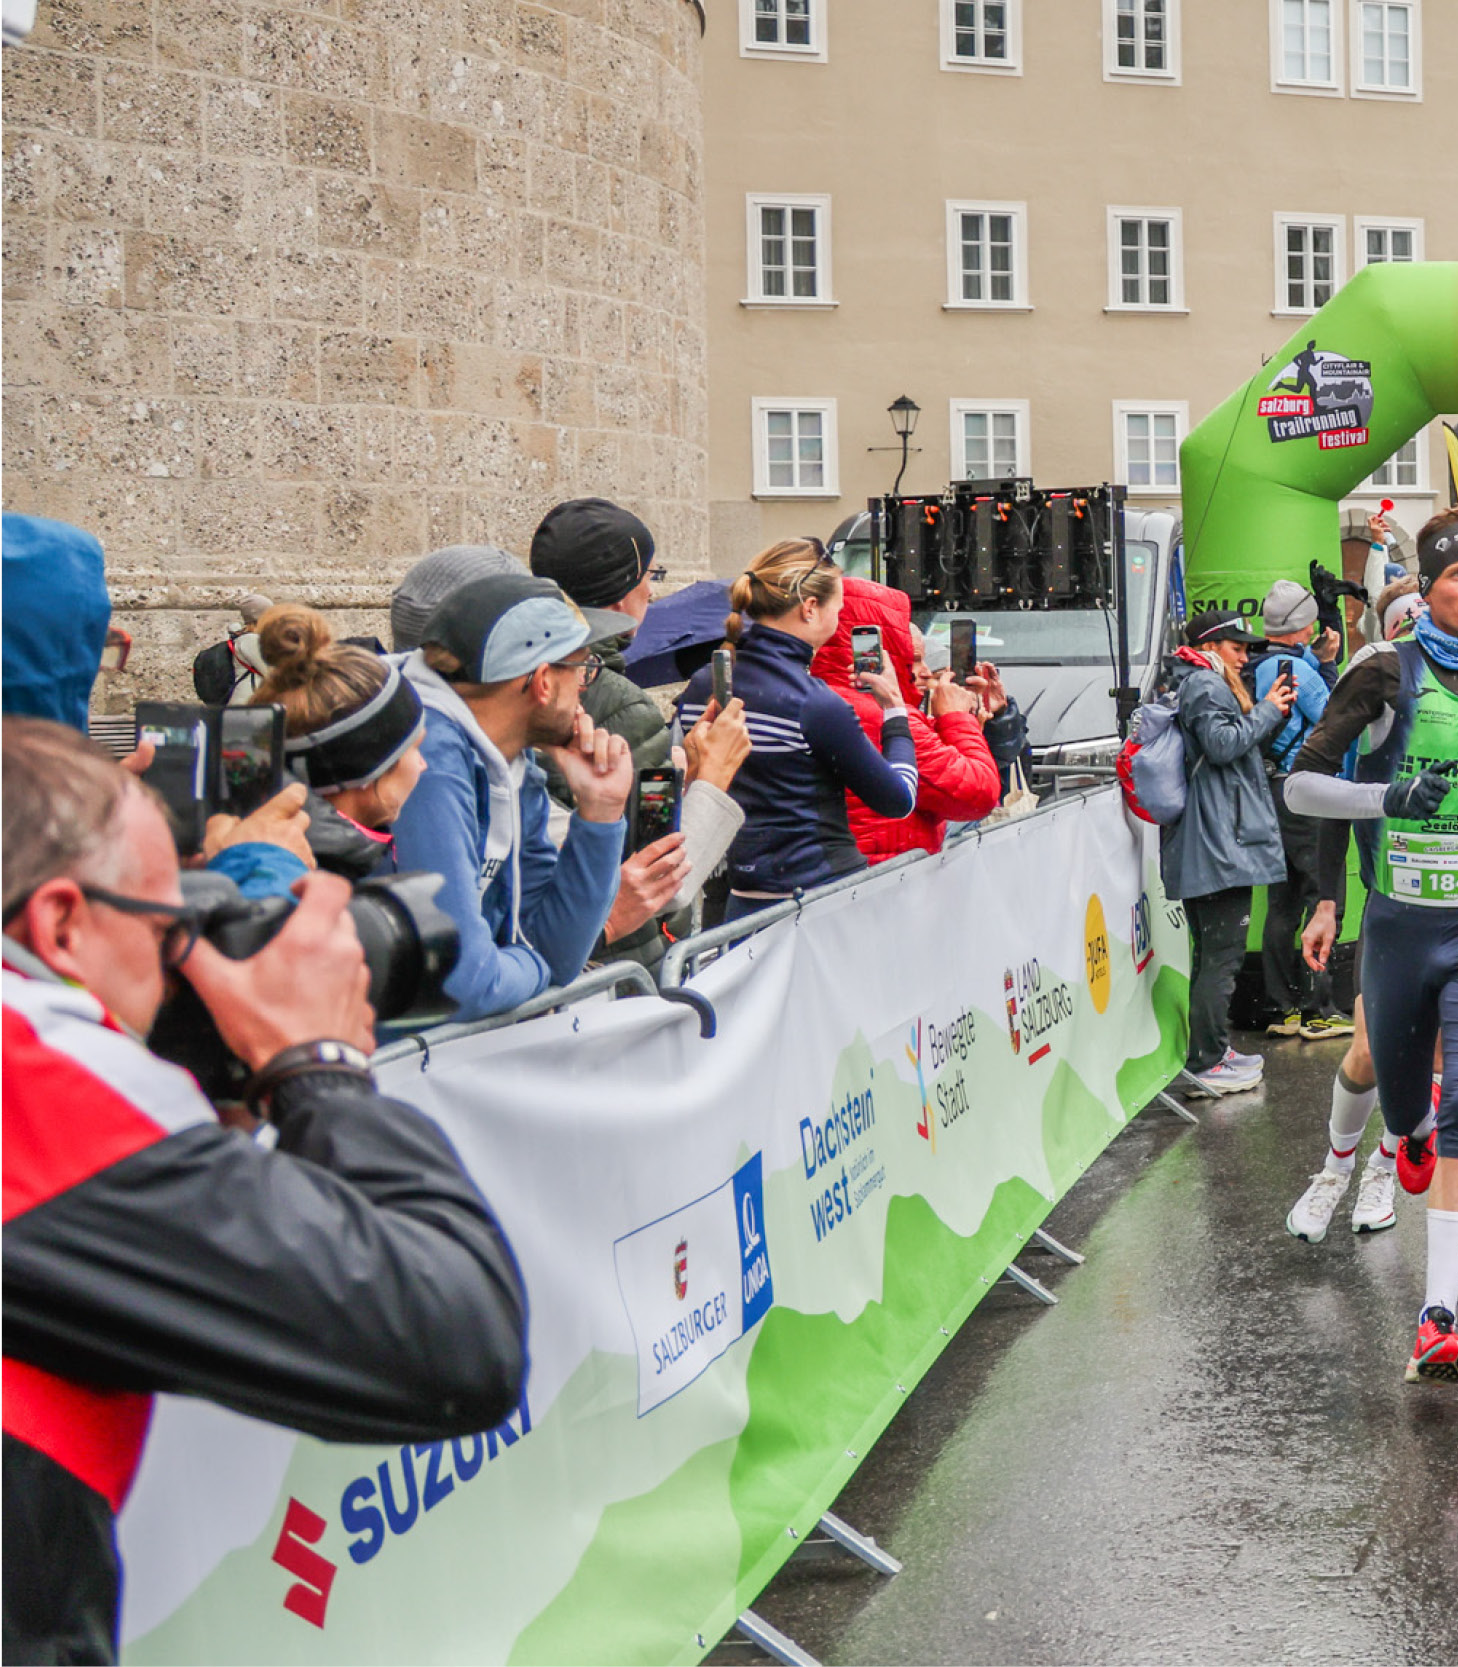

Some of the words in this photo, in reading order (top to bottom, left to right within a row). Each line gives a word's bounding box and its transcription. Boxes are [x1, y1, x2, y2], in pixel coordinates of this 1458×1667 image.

[1259, 397, 1310, 416] salzburg
[1273, 408, 1359, 438] trailrunning
[1322, 429, 1367, 448] festival
[1016, 957, 1041, 1003] LAND
[928, 1005, 976, 1070] Bewegte
[1020, 983, 1073, 1044] SALZBURG
[936, 1069, 970, 1129] Stadt
[810, 1165, 852, 1243] west
[742, 1251, 771, 1305] UNIQA
[652, 1291, 728, 1375] SALZBURGER
